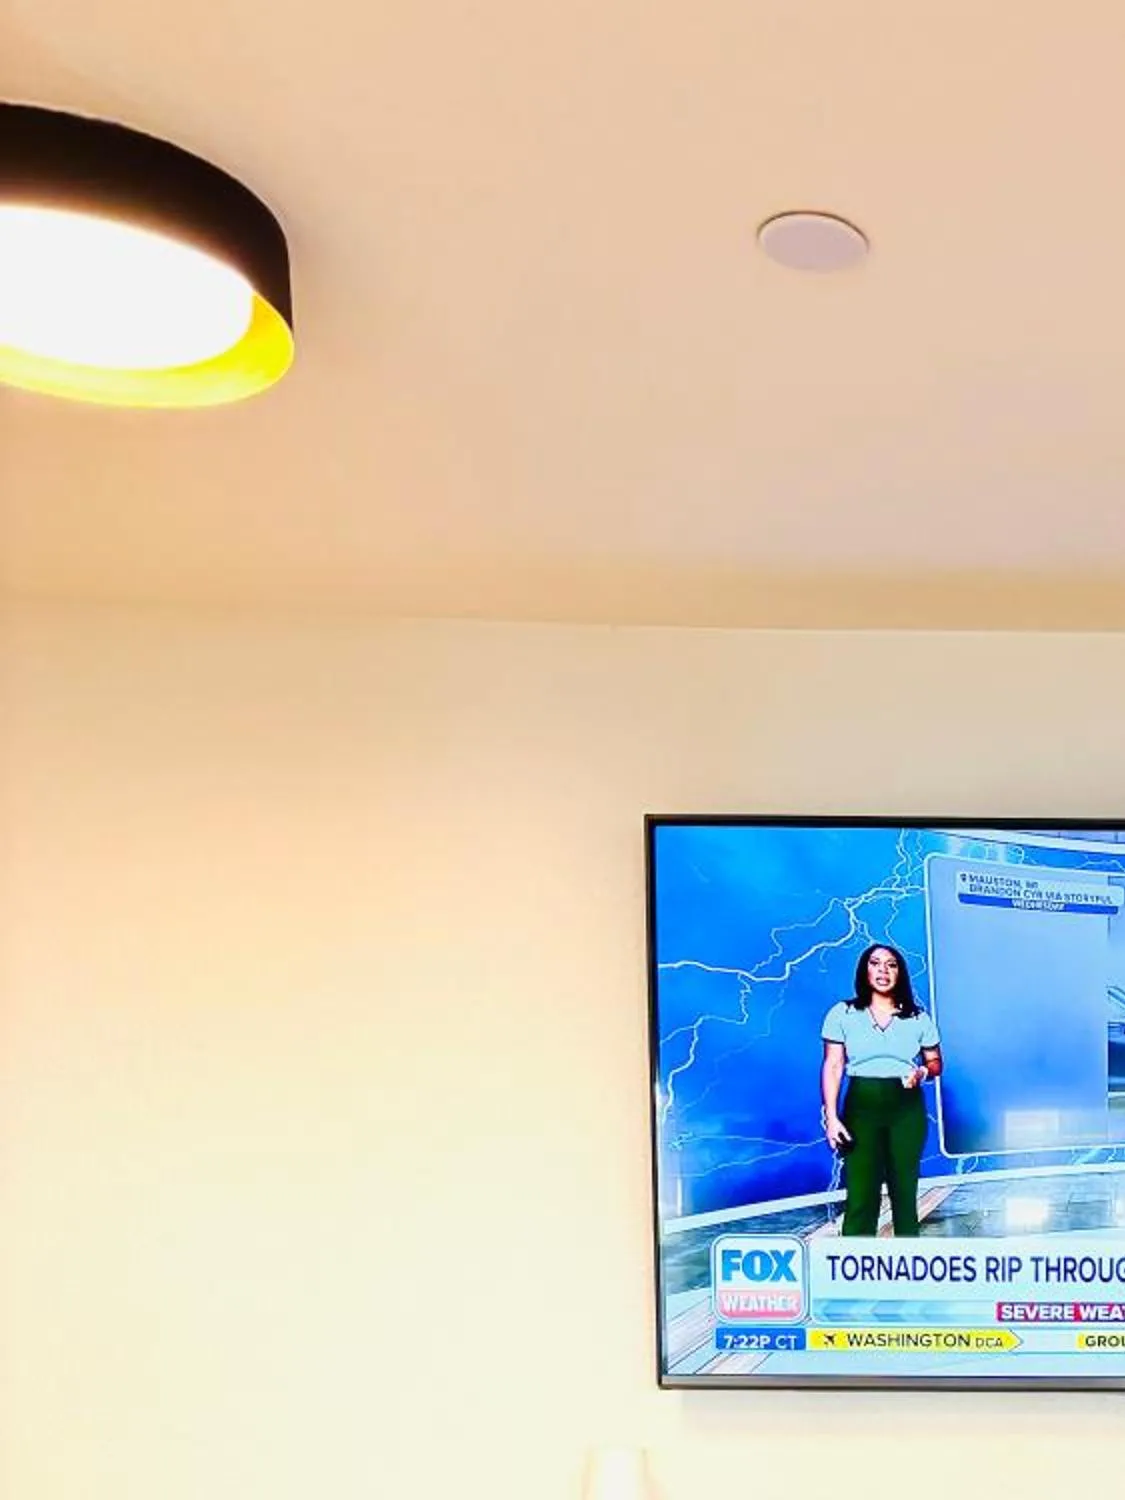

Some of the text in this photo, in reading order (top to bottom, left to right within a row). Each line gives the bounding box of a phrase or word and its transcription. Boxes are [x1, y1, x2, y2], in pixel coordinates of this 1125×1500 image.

[721, 1249, 798, 1282] FOX
[826, 1255, 977, 1282] TORNADOES
[985, 1256, 1023, 1283] RIP
[722, 1293, 798, 1313] WEATHER
[1001, 1304, 1074, 1321] SEVERE
[724, 1335, 797, 1349] 7:22P CT
[846, 1333, 972, 1348] WASHINGTON
